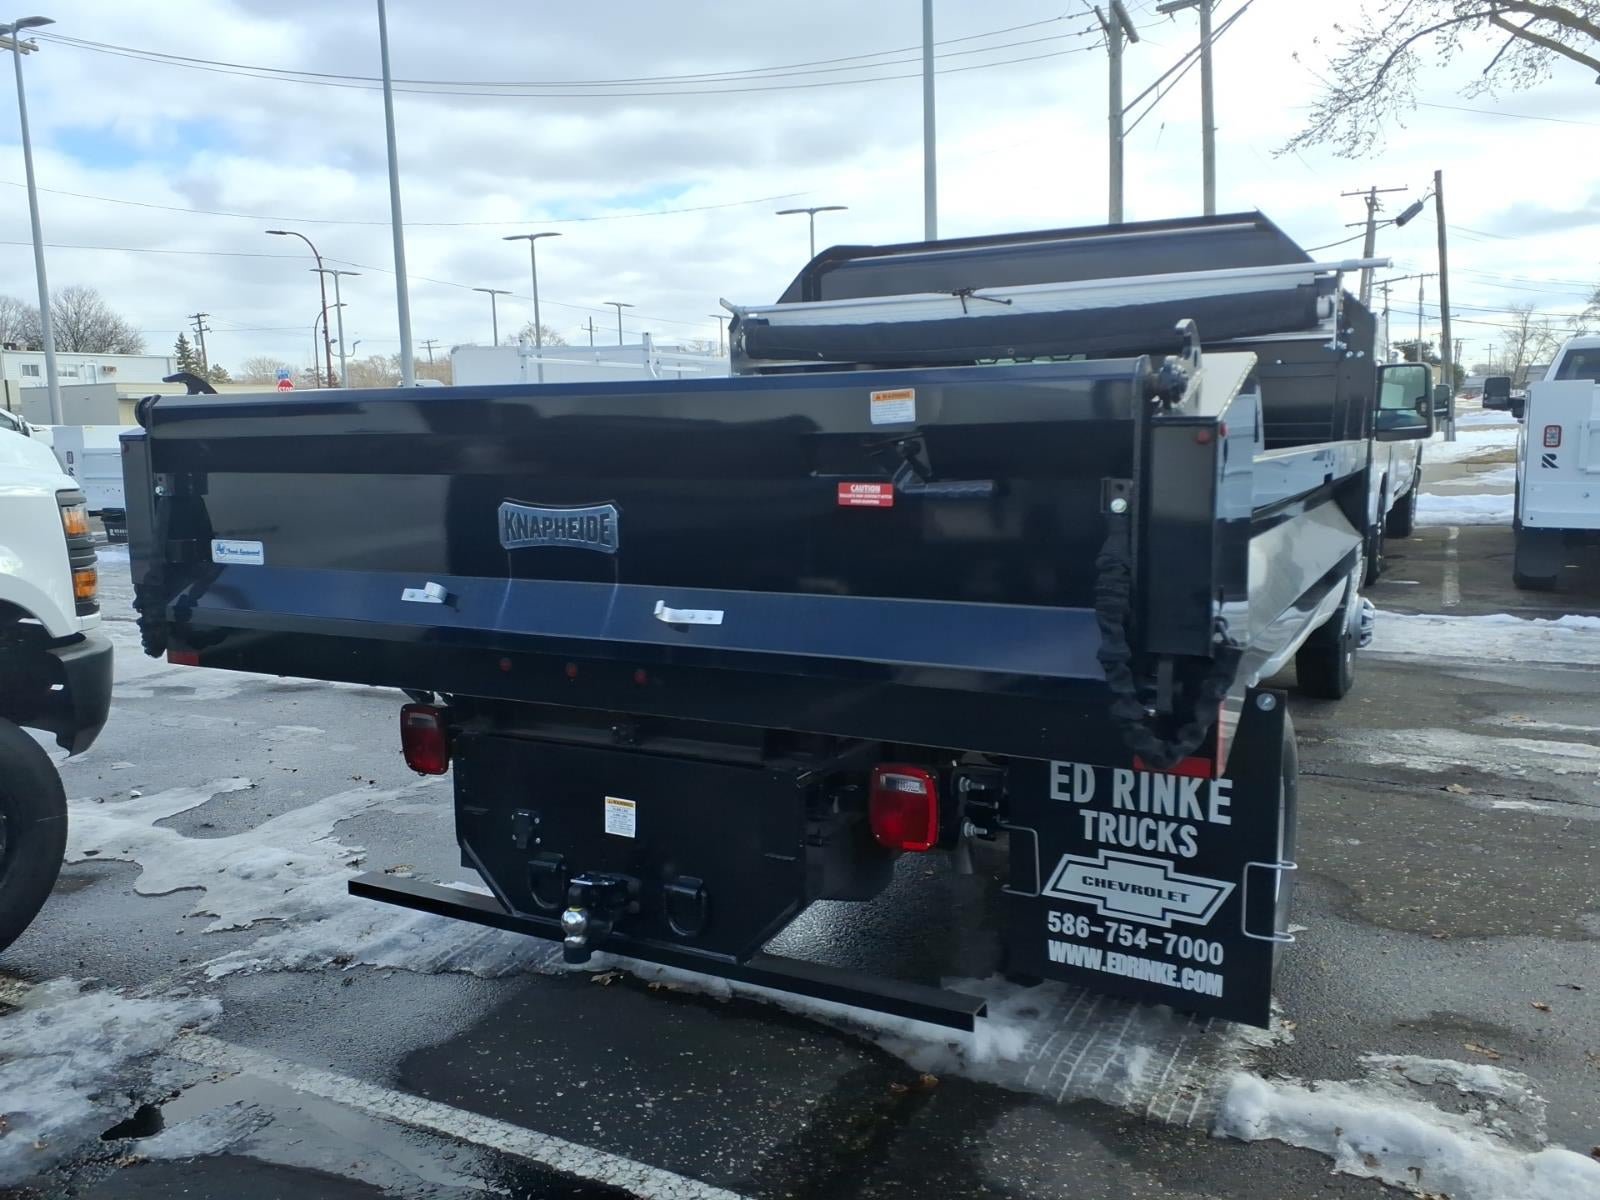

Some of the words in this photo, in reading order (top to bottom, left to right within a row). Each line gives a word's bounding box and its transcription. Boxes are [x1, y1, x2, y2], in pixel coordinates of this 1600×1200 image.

[850, 484, 881, 494] CAUTION
[503, 509, 612, 548] KNAPHEIDE
[1049, 759, 1096, 804] ED
[1112, 767, 1233, 826] RINKE
[1079, 809, 1199, 859] TRUCKS
[1081, 875, 1191, 904] CHEVROLET
[1047, 910, 1225, 966] 586-754-7000
[1047, 939, 1224, 998] WWW.EDRINKE.COM
